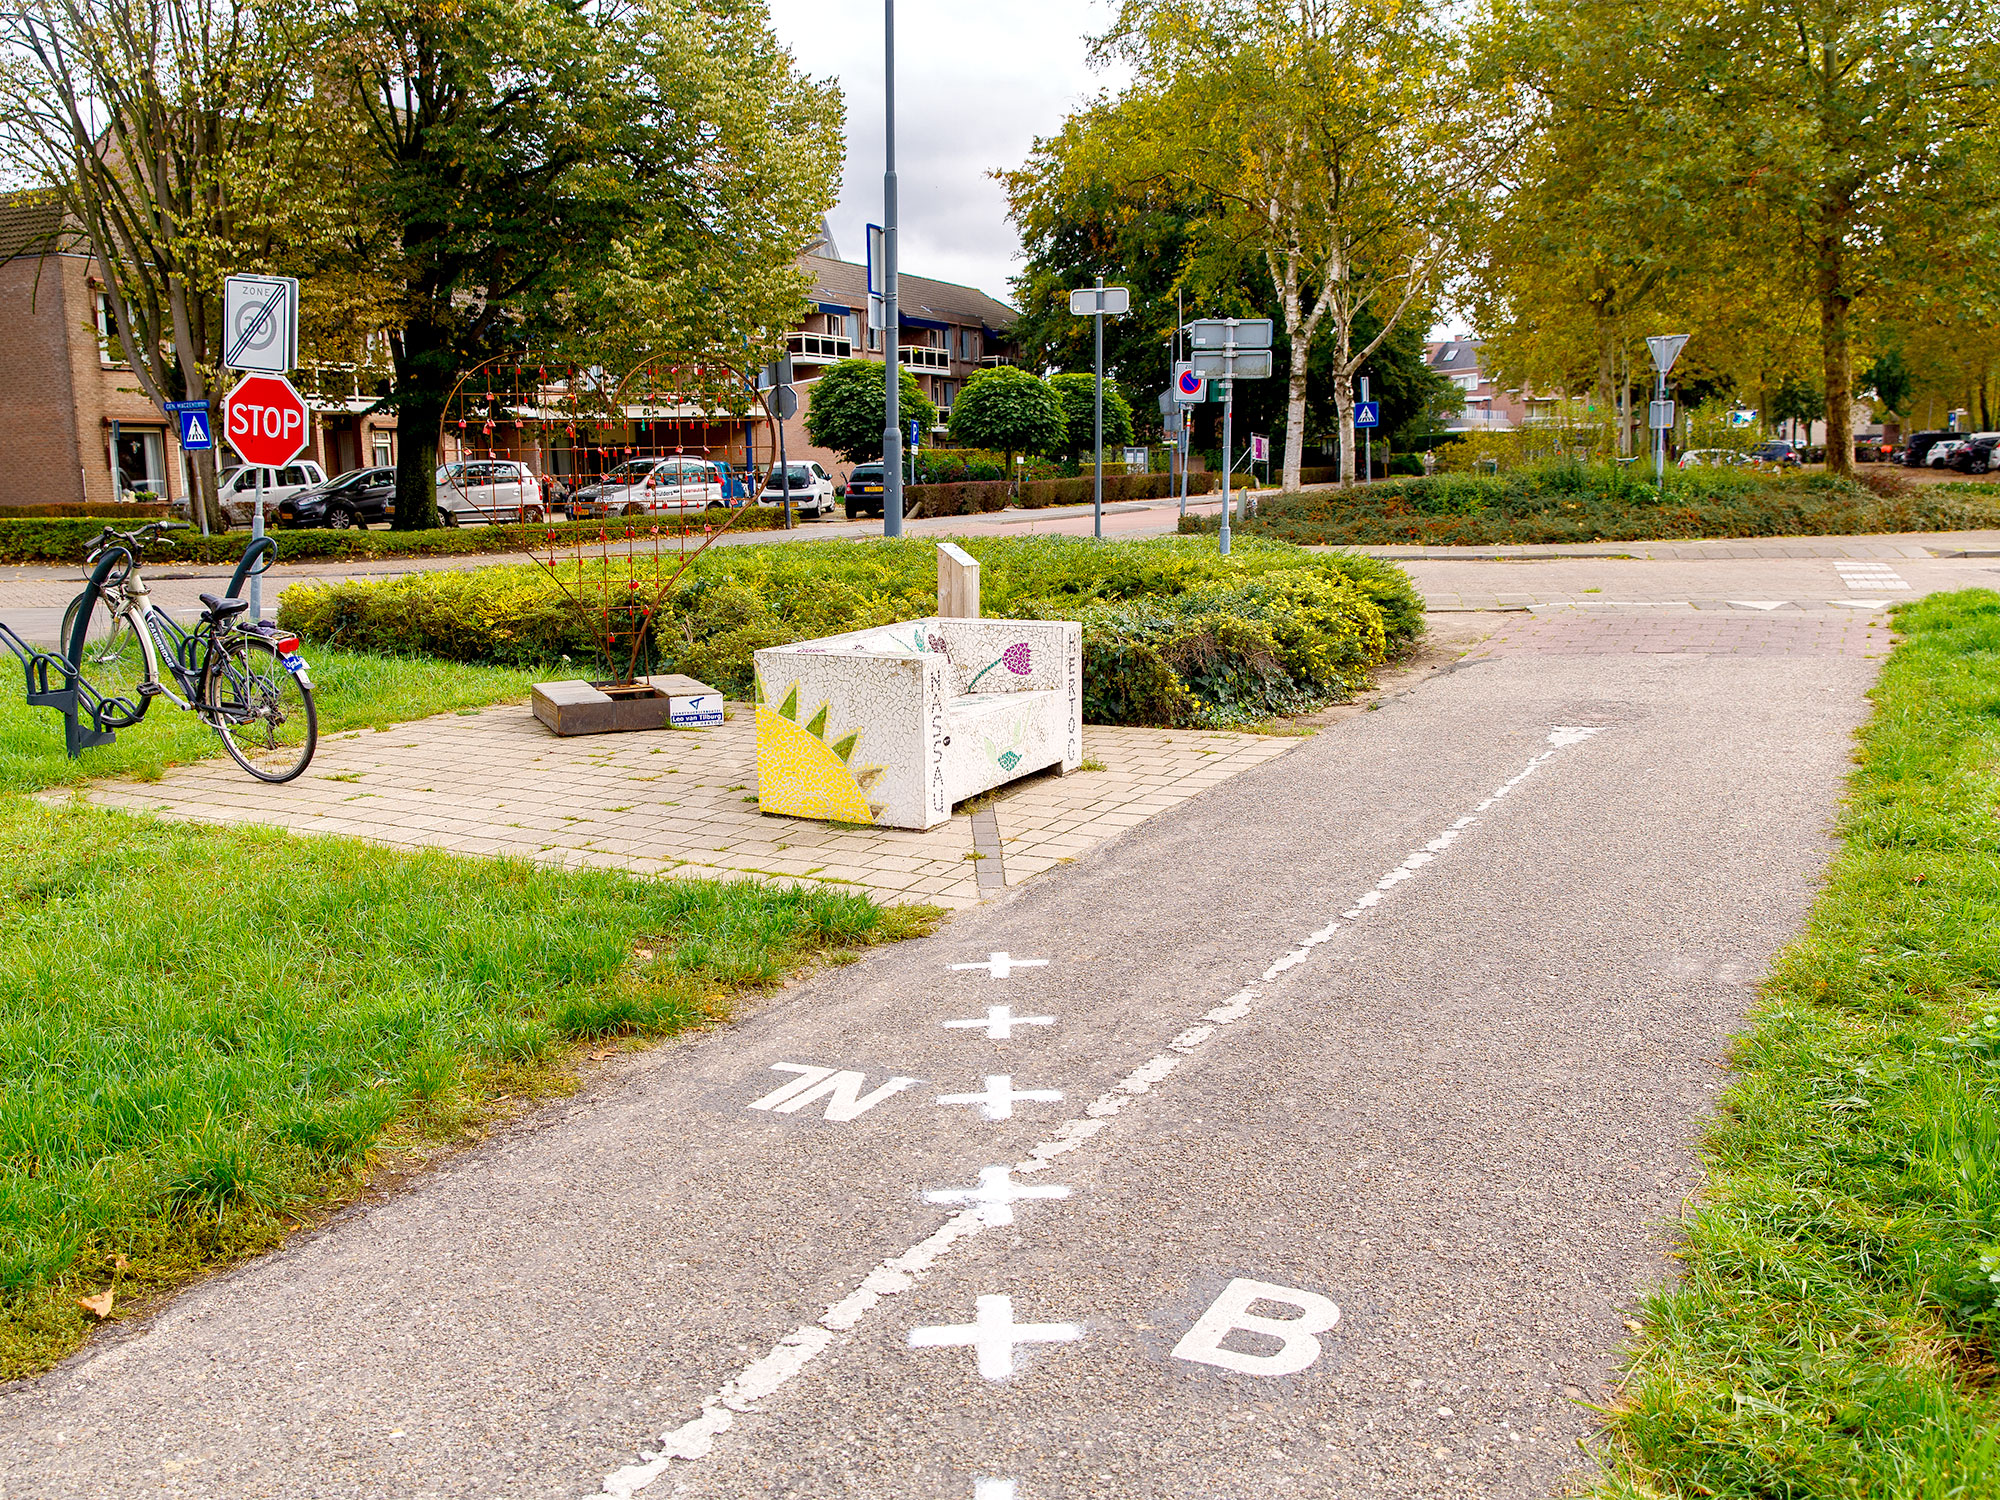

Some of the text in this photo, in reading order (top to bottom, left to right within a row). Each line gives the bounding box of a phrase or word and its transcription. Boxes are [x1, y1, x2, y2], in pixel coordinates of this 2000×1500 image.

[242, 286, 270, 297] ZONE
[231, 402, 301, 440] STOP
[148, 621, 175, 668] CAMBRIDGE
[699, 713, 722, 721] Tilburg
[931, 669, 944, 814] NASSAU
[1170, 1277, 1341, 1376] B
